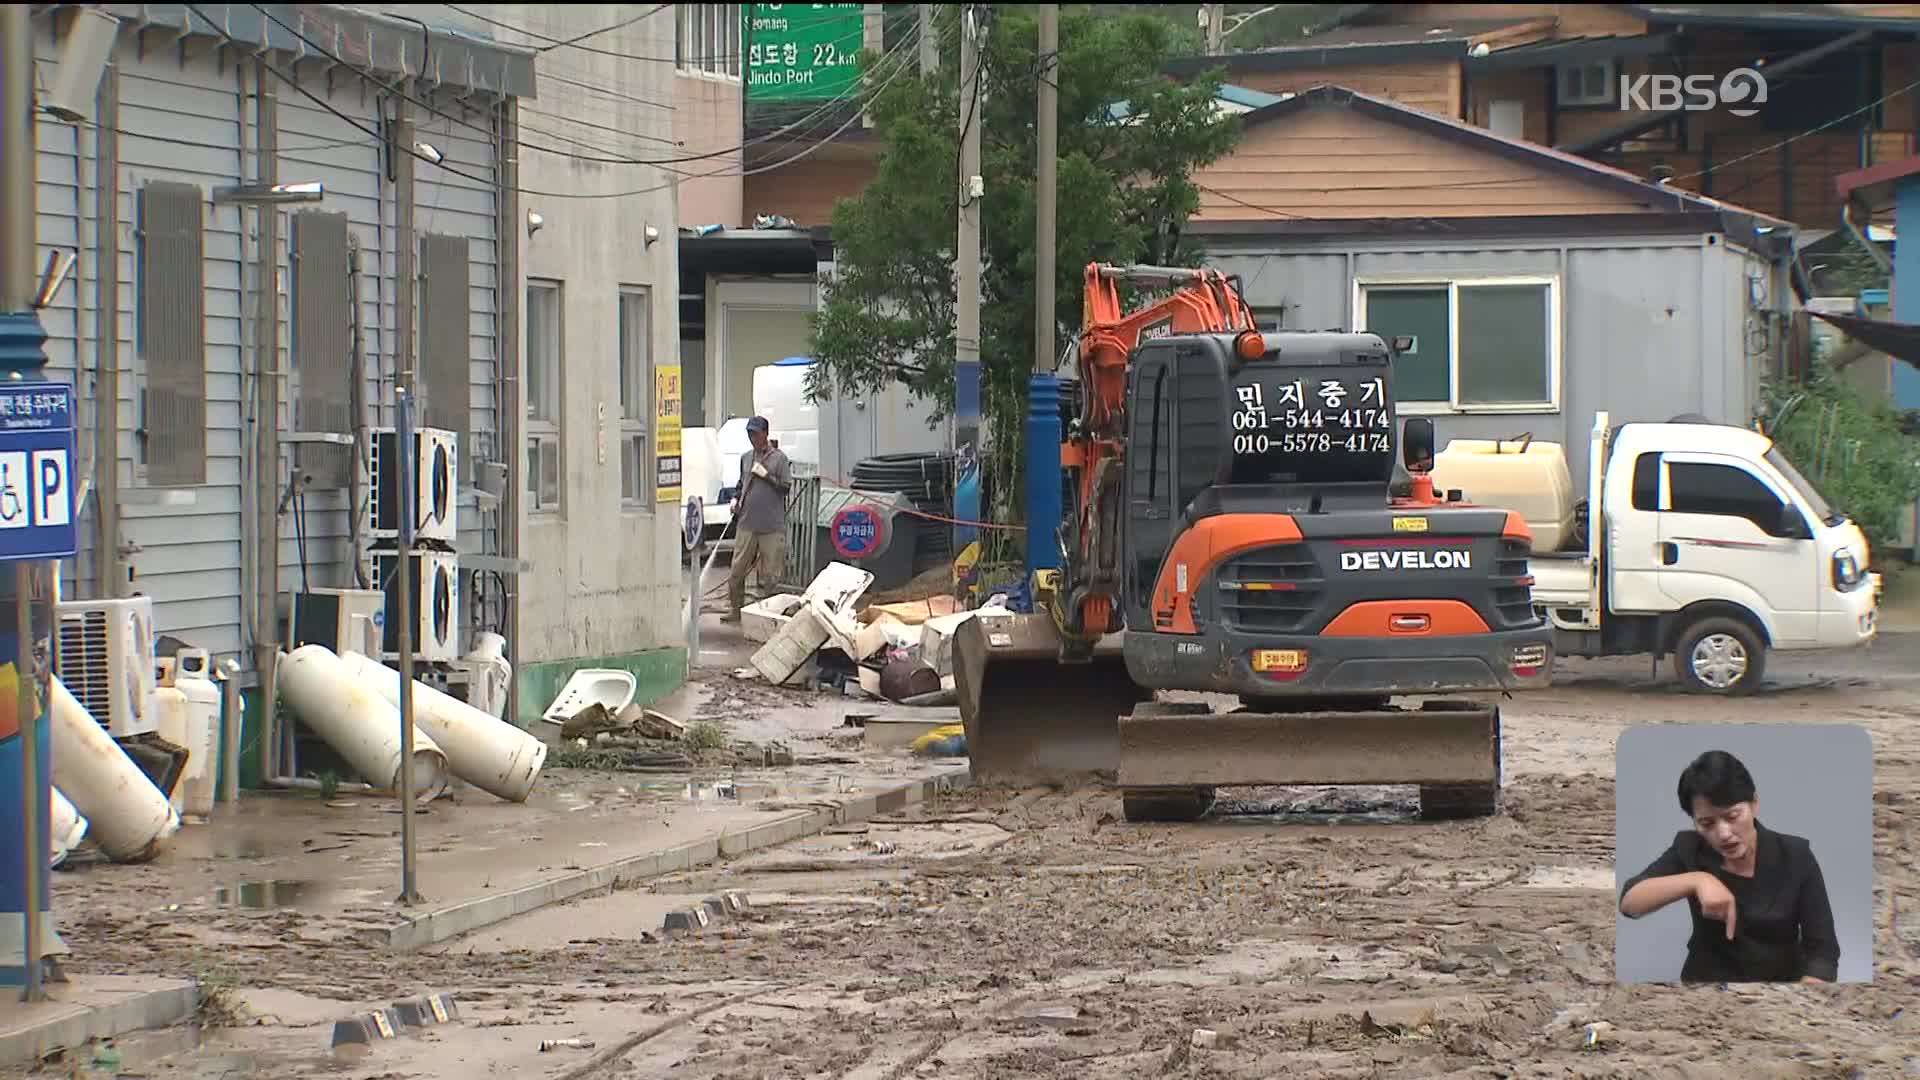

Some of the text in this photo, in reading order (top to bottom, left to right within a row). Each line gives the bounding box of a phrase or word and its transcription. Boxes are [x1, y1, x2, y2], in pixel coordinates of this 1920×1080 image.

[749, 42, 798, 66] 진도항
[812, 43, 835, 66] 22
[747, 69, 814, 85] Jindo Port
[1232, 409, 1390, 430] 061-544-4174
[1233, 432, 1391, 454] 010-5578-4174
[41, 459, 60, 520] P
[1340, 550, 1471, 570] DEVELON
